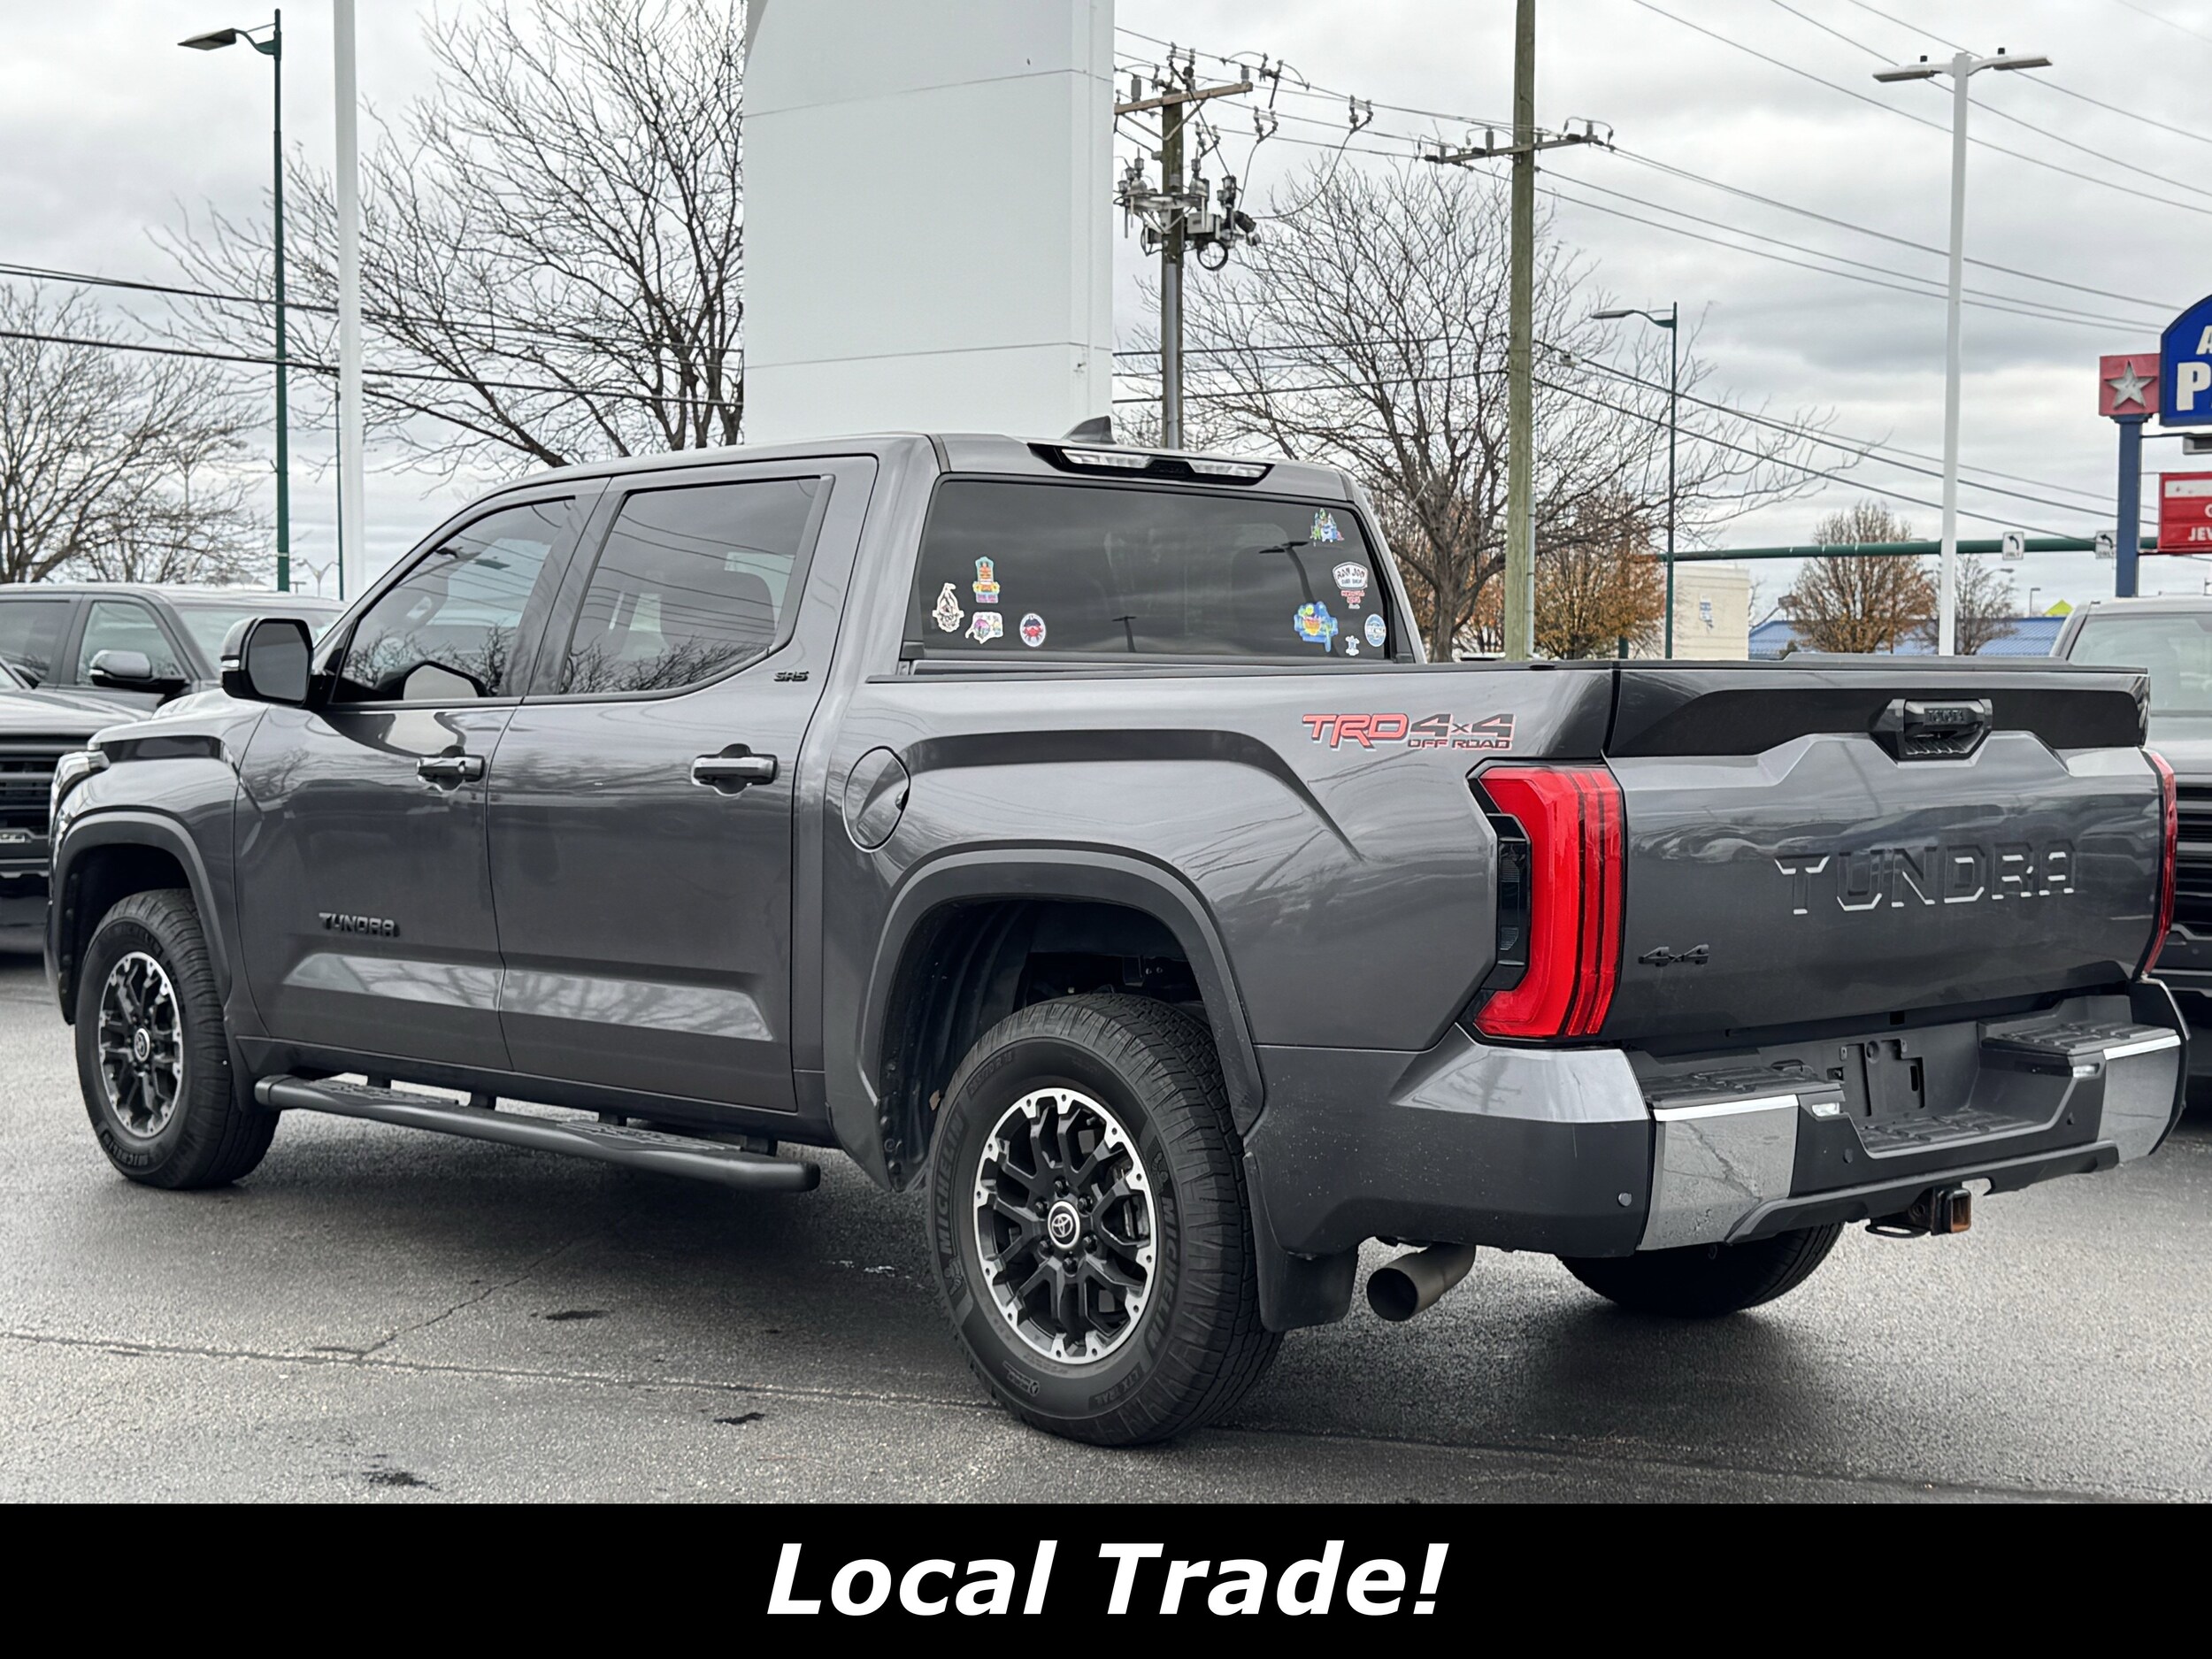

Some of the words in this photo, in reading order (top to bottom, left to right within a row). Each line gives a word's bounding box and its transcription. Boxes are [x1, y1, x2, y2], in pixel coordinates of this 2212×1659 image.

[2177, 362, 2212, 411] P
[773, 671, 810, 682] SR5
[1302, 713, 1409, 751] TRD
[1407, 738, 1448, 750] OFF
[1451, 738, 1514, 751] ROAD
[1774, 839, 2076, 915] TUNDRA
[319, 911, 399, 937] TUNDRA
[934, 1110, 966, 1256] MICHELIN
[1148, 1195, 1179, 1352] MICHELIN
